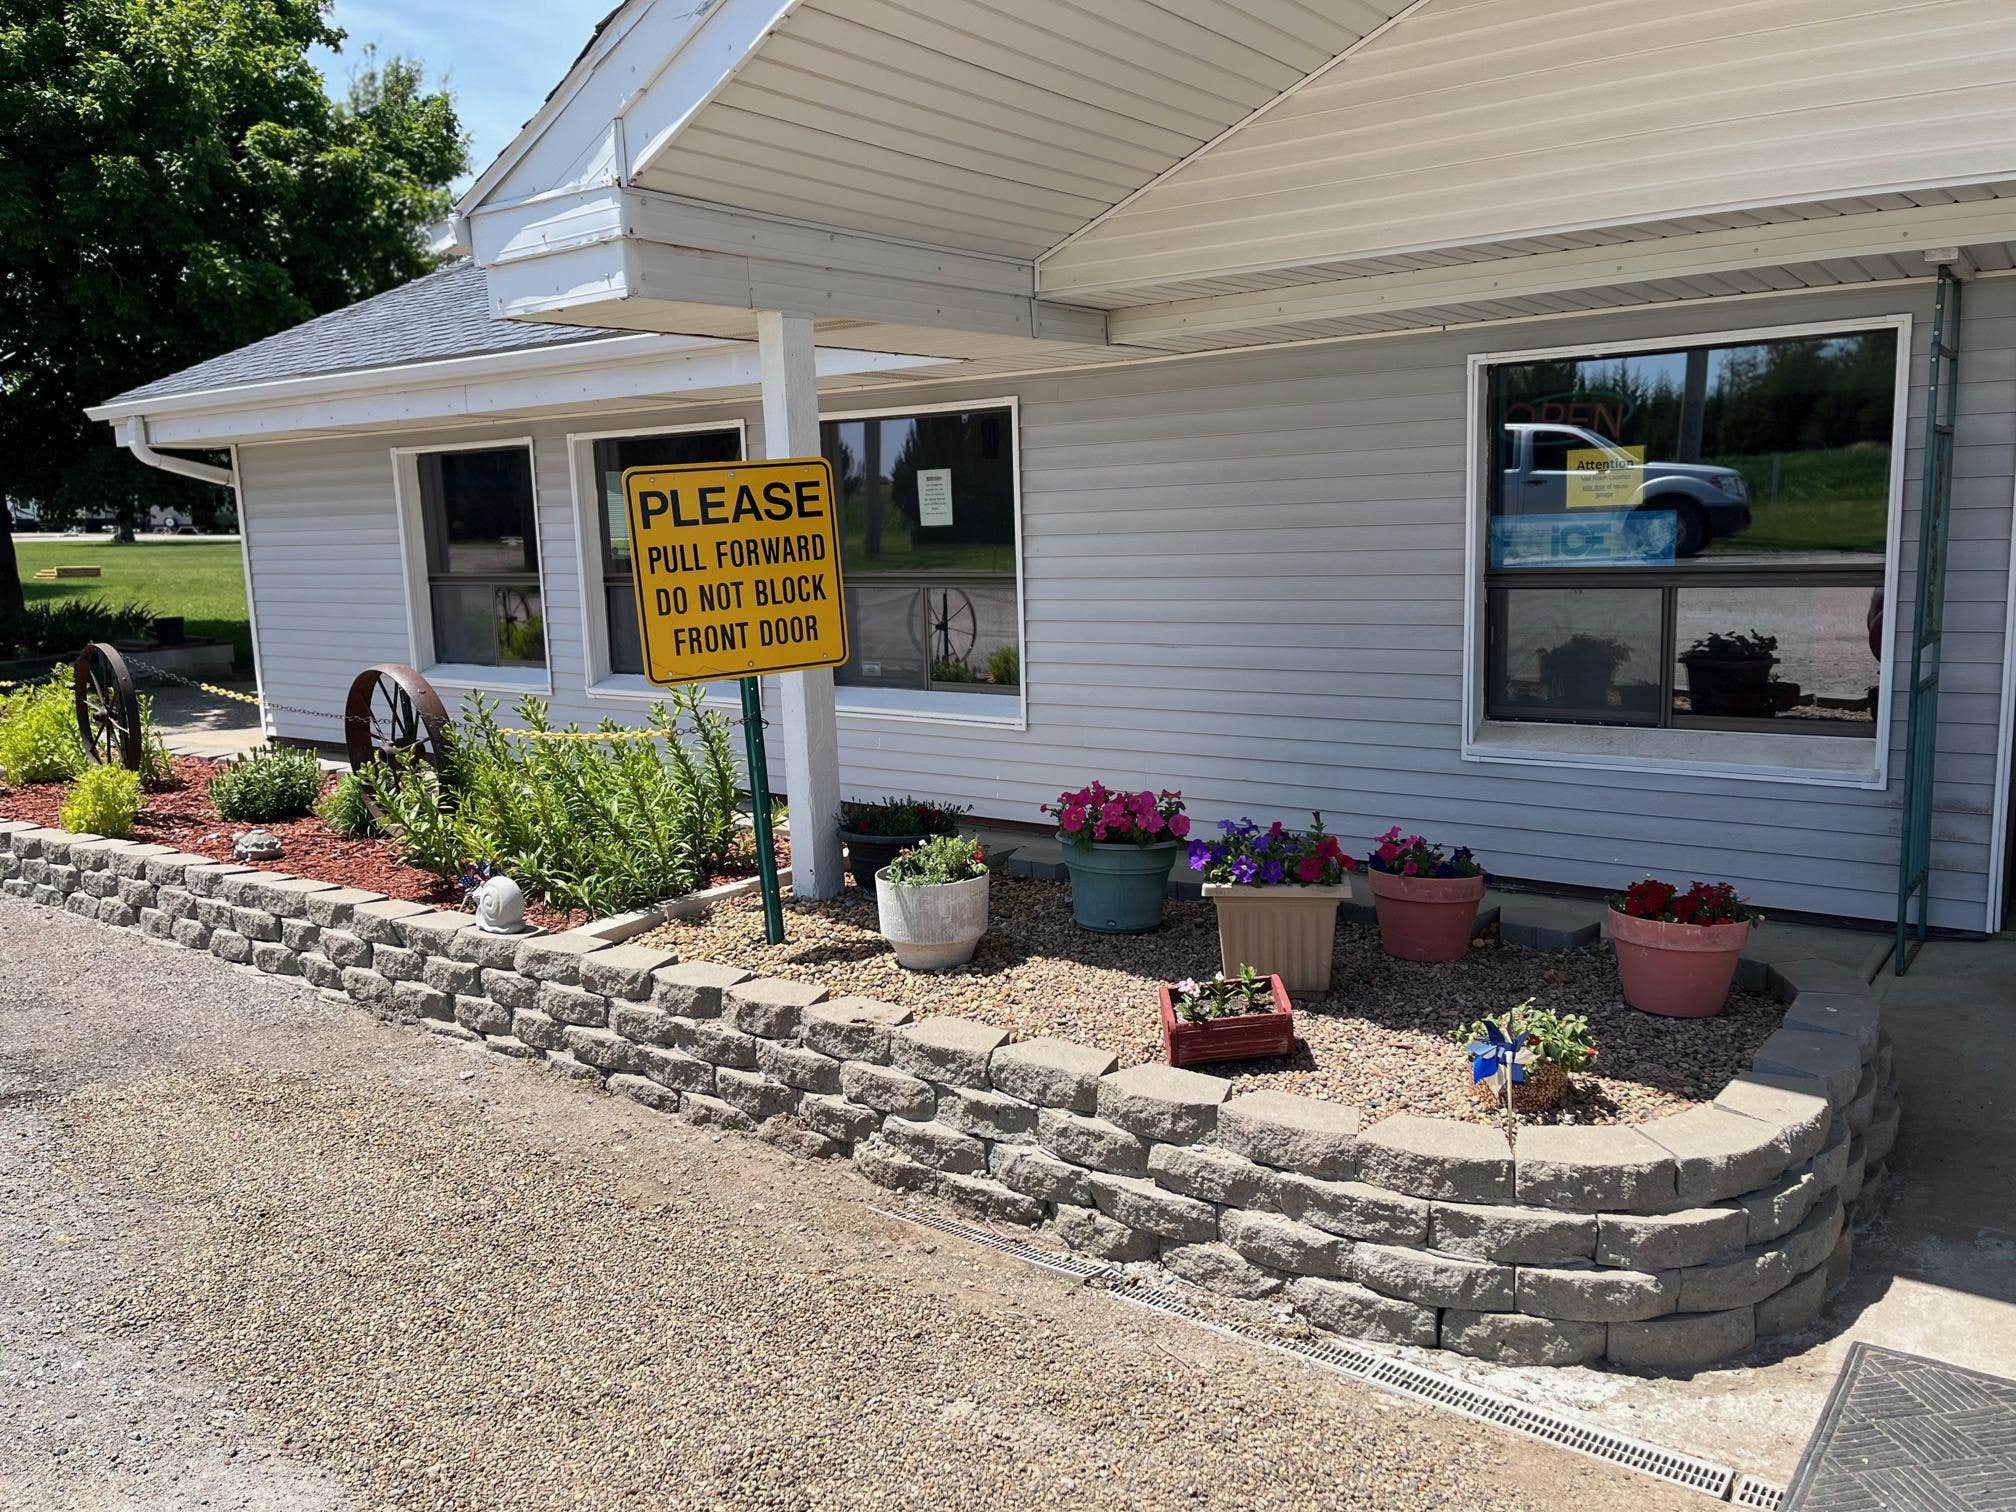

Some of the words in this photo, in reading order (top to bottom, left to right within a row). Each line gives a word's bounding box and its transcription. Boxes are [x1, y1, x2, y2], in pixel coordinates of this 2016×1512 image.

[1577, 458, 1634, 471] Attention
[639, 481, 824, 529] PLEASE
[648, 544, 707, 575] PULL
[716, 534, 826, 569] FORWARD
[656, 587, 688, 616] DO
[700, 582, 744, 612] NOT
[755, 574, 827, 606] BLOCK
[674, 622, 749, 656] FRONT
[760, 615, 818, 647] DOOR
